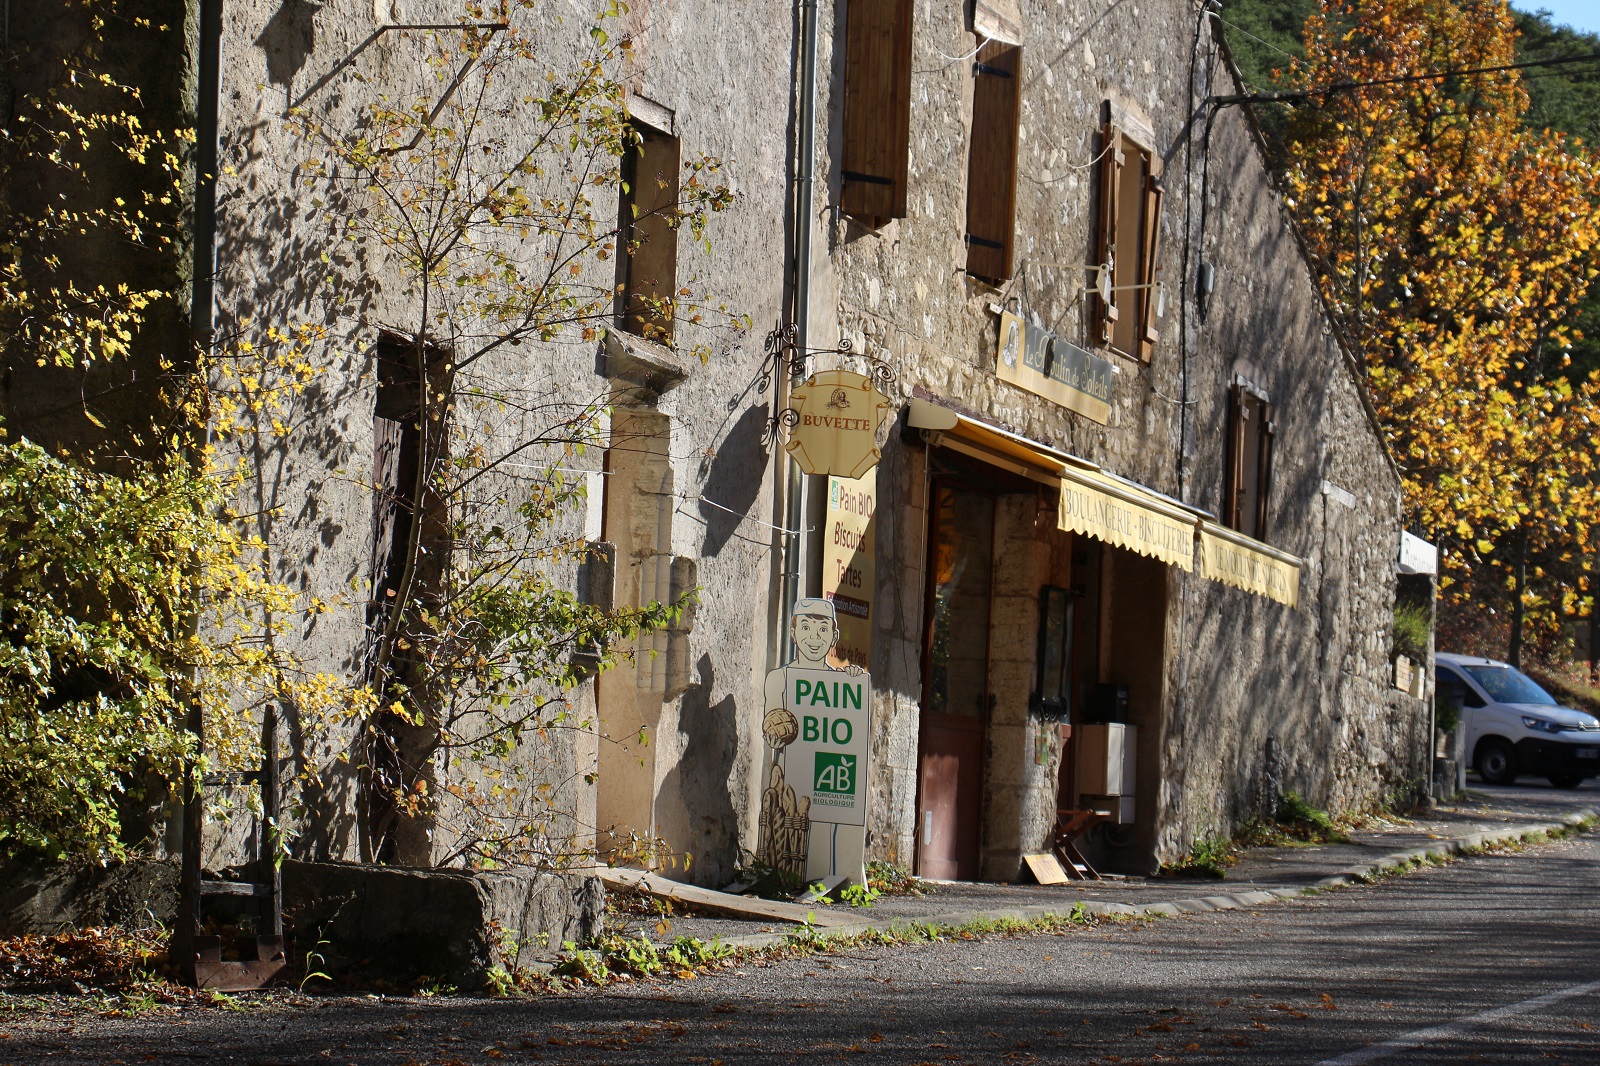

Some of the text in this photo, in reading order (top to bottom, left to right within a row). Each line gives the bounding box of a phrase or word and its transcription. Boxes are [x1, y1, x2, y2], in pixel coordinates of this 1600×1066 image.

[1026, 344, 1034, 365] Le
[1072, 367, 1079, 387] de
[1081, 355, 1108, 400] Soleils
[803, 414, 871, 431] BUVETTE
[840, 485, 873, 518] Pain BIO
[834, 521, 866, 553] Biscuits
[1065, 488, 1132, 536] BOULANGERIE
[1139, 515, 1191, 557] BISCUITERIE
[836, 558, 862, 589] Tartes
[795, 679, 862, 710] PAIN
[803, 715, 853, 745] BIO
[816, 764, 851, 792] AB
[813, 792, 855, 801] AGRICULTURE
[813, 798, 855, 807] BIOLOGIQUE
